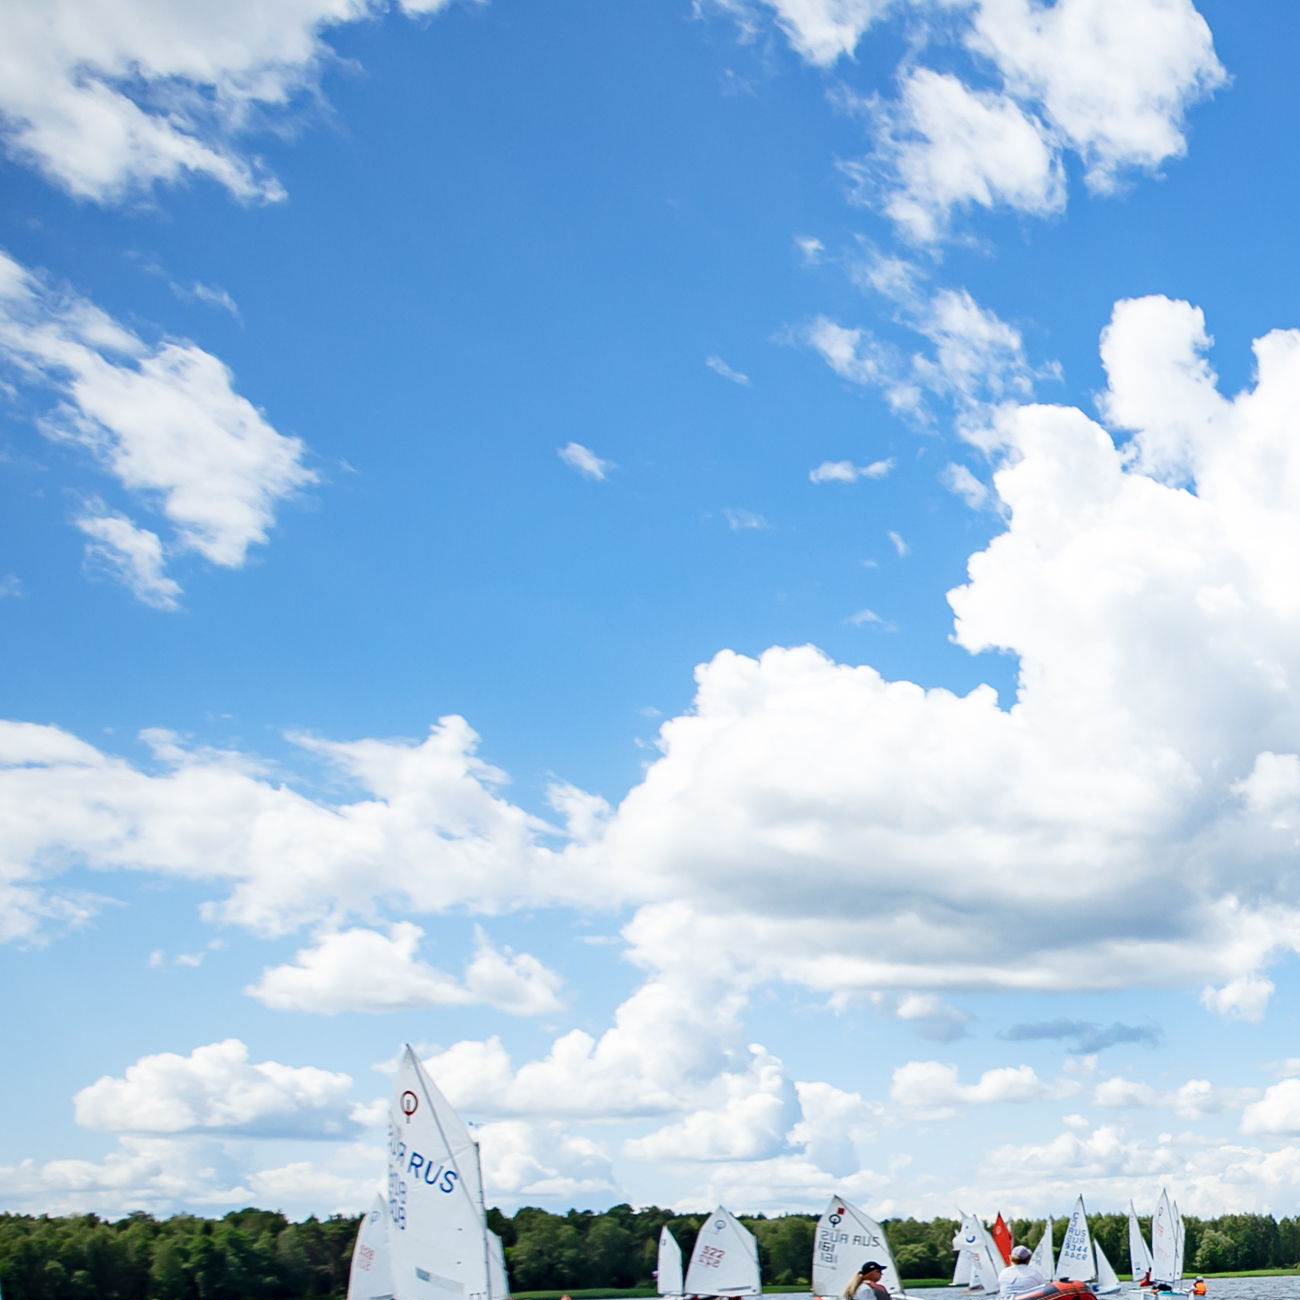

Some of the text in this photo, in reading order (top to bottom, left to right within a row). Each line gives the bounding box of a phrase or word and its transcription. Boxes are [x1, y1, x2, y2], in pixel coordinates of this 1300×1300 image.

[407, 1151, 458, 1194] RUS
[1068, 1227, 1087, 1237] RUS
[852, 1235, 880, 1247] RUS
